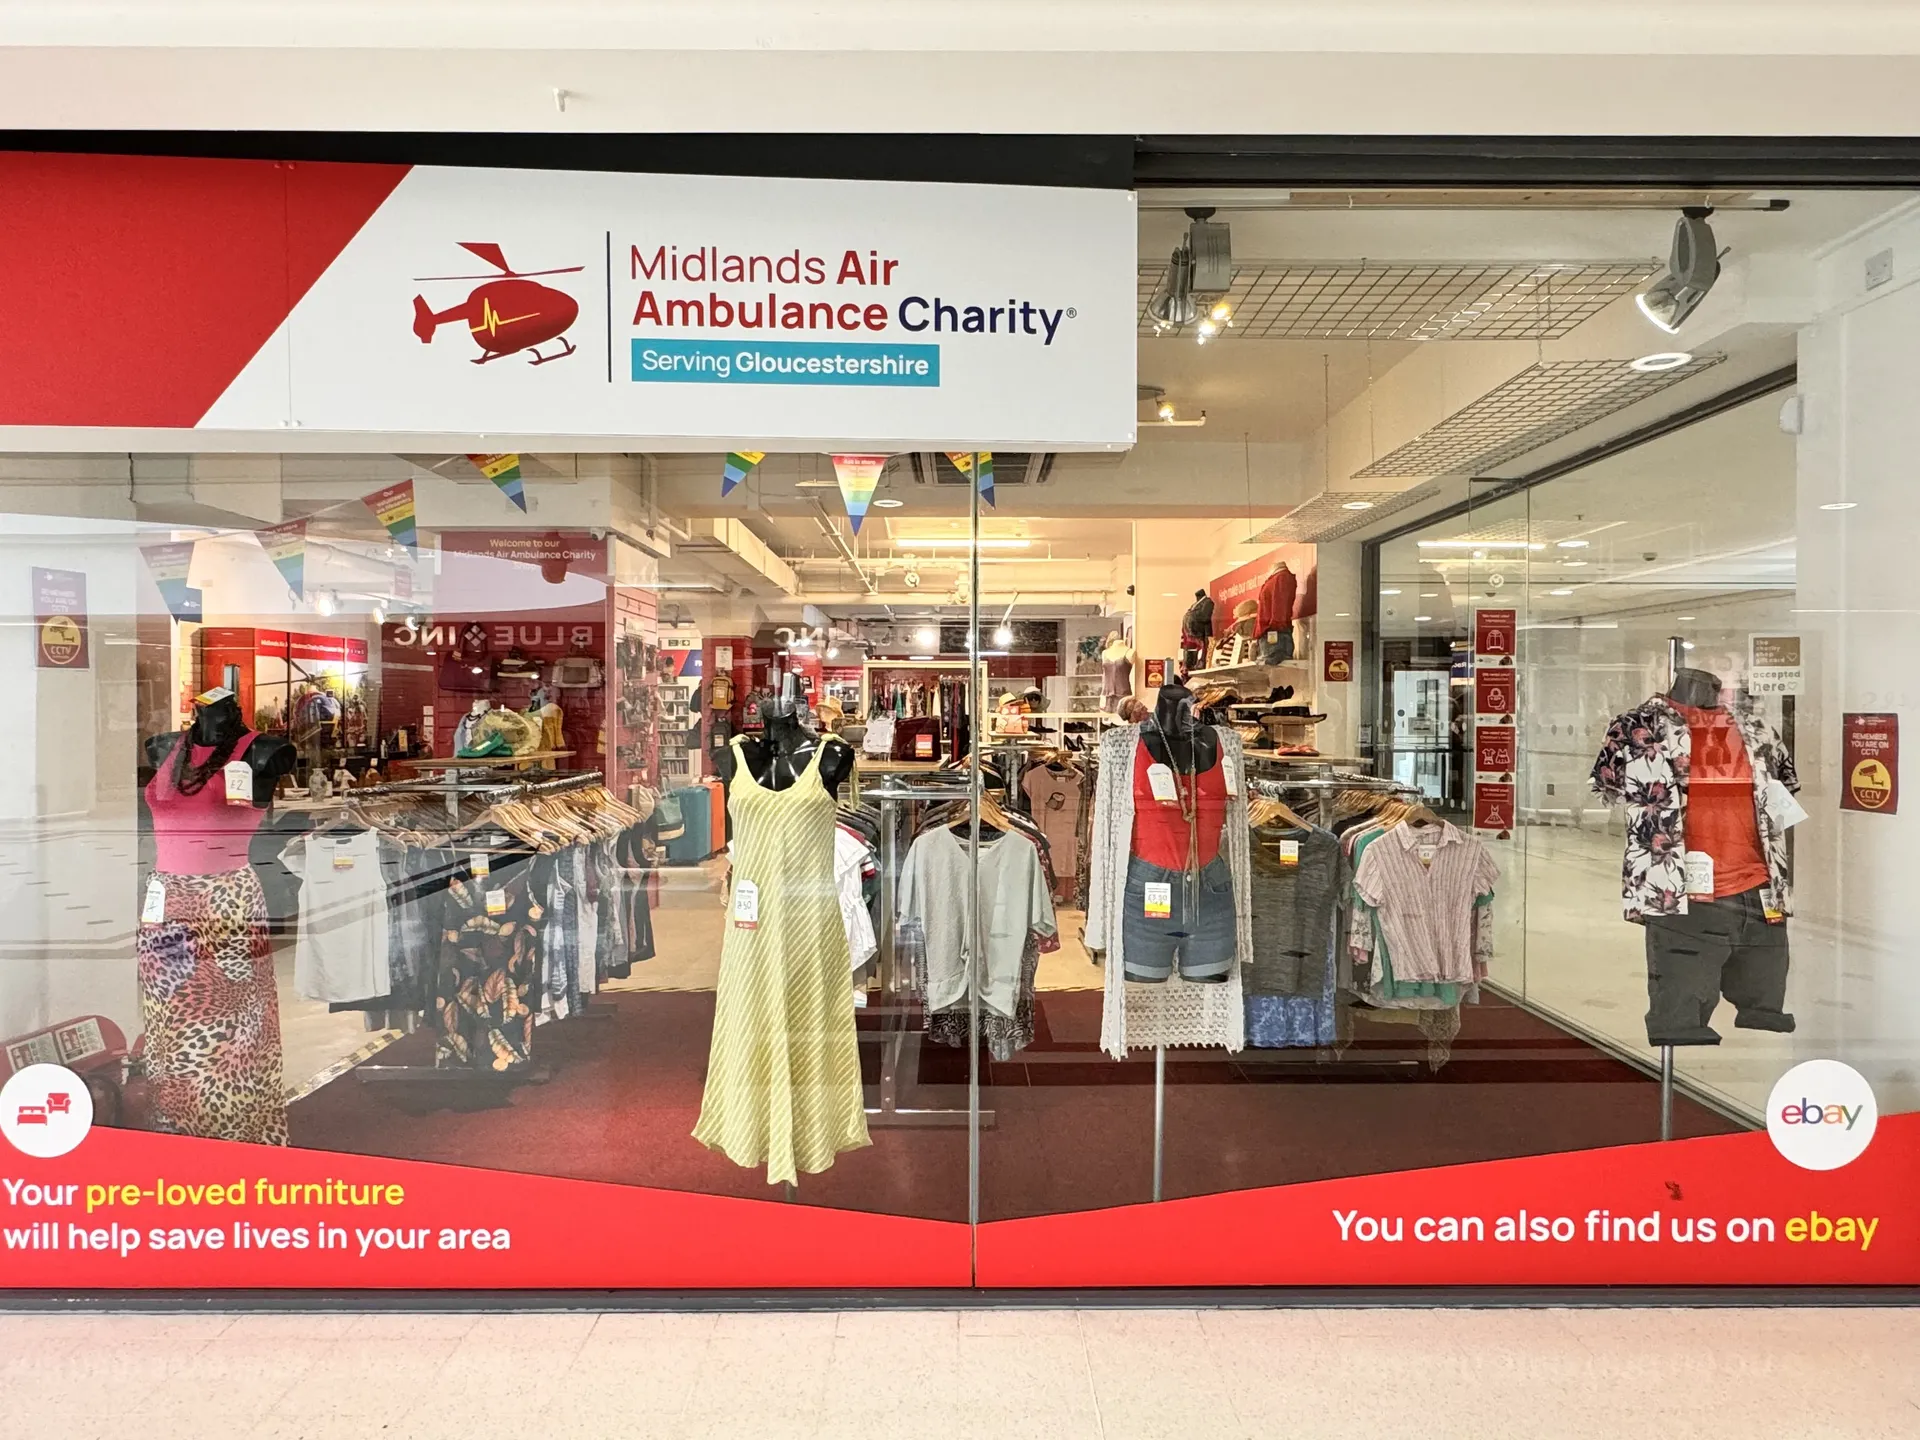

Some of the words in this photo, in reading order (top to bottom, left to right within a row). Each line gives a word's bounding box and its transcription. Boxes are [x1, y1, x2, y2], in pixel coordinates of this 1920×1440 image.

[631, 244, 826, 284] Midlands
[836, 250, 899, 286] Air
[632, 291, 888, 331] Ambulance
[642, 350, 731, 378] Serving
[735, 351, 929, 375] Gloucestershire
[489, 539, 532, 548] Welcome
[532, 539, 544, 548] to
[544, 540, 561, 548] our
[510, 551, 562, 559] Ambulance
[562, 551, 596, 562] Charity
[51, 645, 72, 655] CCTV
[1752, 671, 1800, 680] accepted
[1753, 681, 1785, 691] here
[1852, 732, 1888, 740] REMEMBER
[1851, 740, 1865, 748] YOU
[1878, 741, 1889, 749] ON
[1860, 748, 1879, 756] CCTV
[1859, 789, 1881, 799] CCTV
[1781, 1097, 1863, 1131] ebay
[2, 1178, 79, 1206] Your
[86, 1178, 246, 1213] pre-loved
[254, 1178, 405, 1206] furniture
[1332, 1210, 1404, 1242] You
[1414, 1216, 1484, 1242] can
[1494, 1209, 1576, 1242] also
[1584, 1209, 1661, 1242] find
[1671, 1217, 1717, 1242] us
[1726, 1216, 1775, 1242] on
[1785, 1210, 1879, 1251] ebay
[4, 1222, 58, 1249] will
[68, 1222, 141, 1257] help
[148, 1227, 225, 1249] save
[233, 1222, 310, 1249] lives
[318, 1221, 347, 1248] in
[355, 1228, 431, 1257] your
[437, 1228, 510, 1250] area
